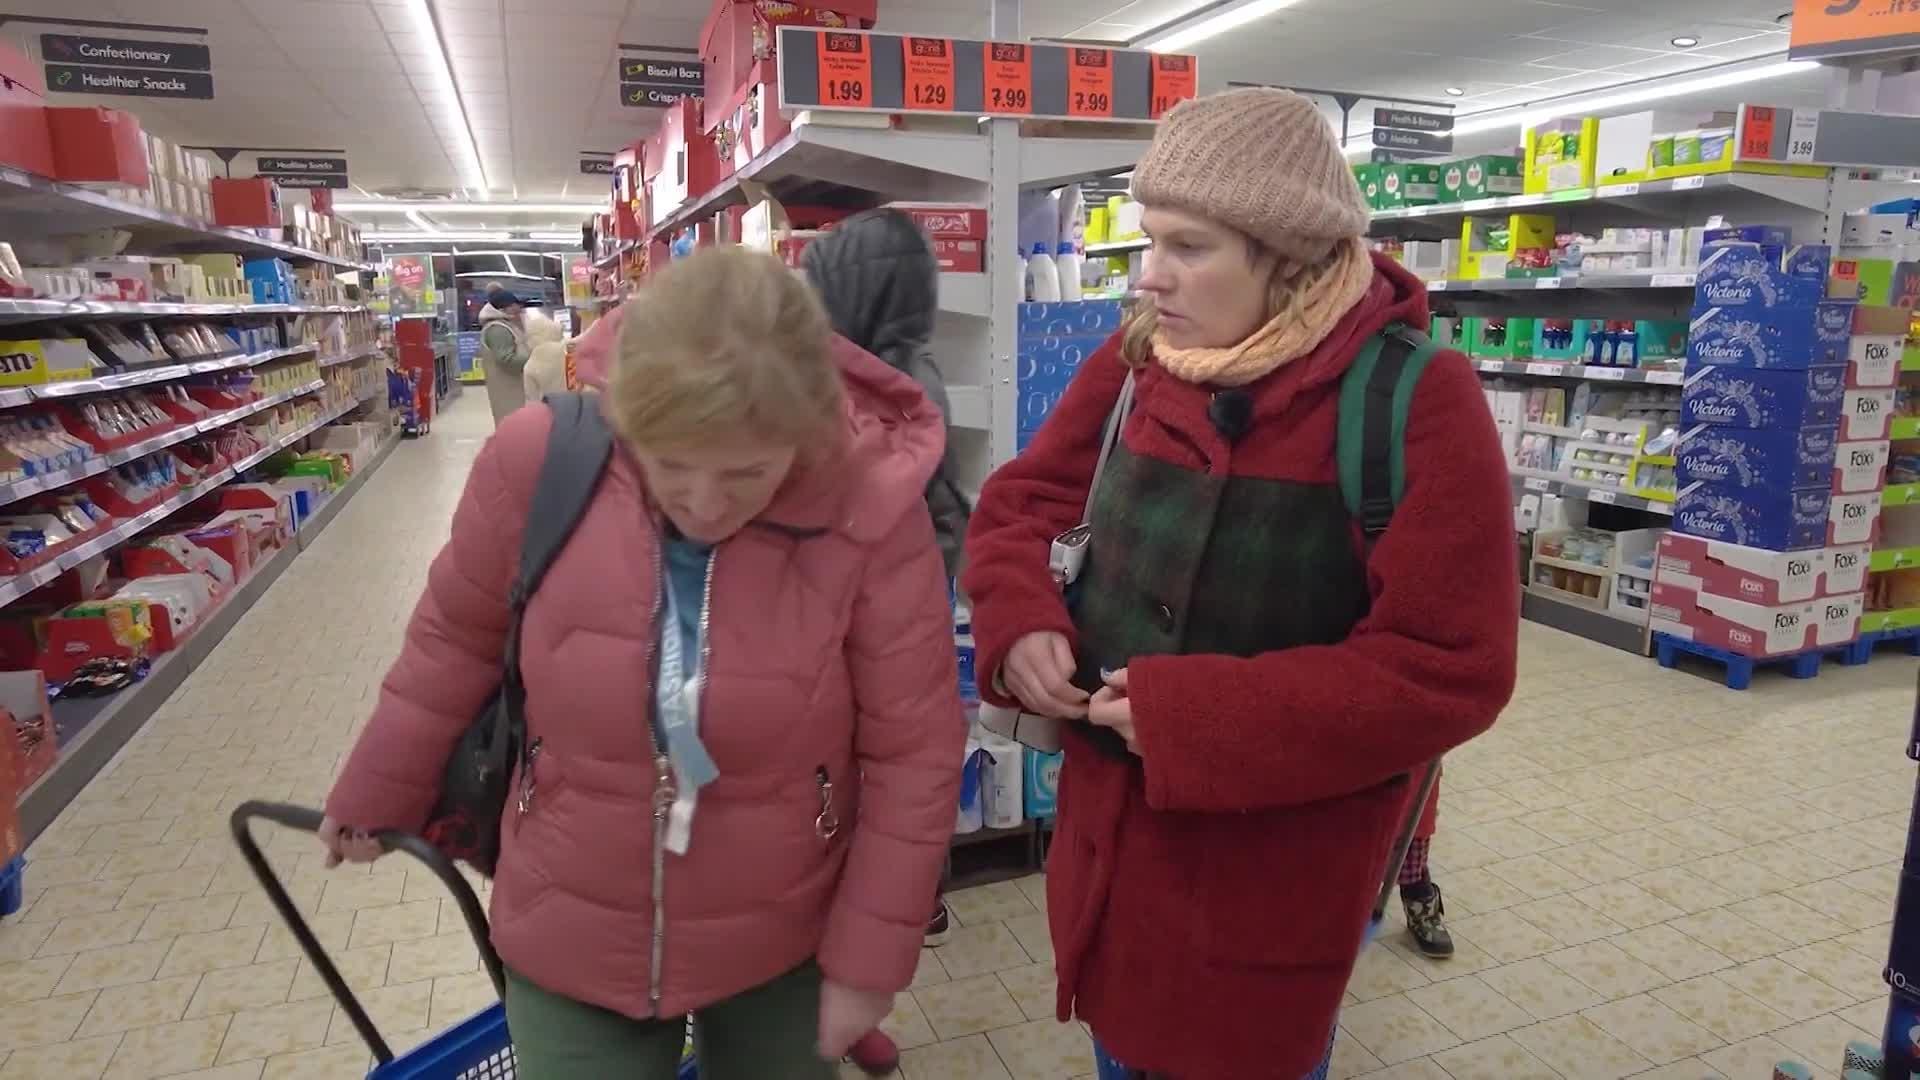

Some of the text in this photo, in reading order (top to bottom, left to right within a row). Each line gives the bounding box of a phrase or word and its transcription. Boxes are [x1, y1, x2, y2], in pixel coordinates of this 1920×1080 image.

[80, 43, 171, 63] Confectionary
[648, 65, 701, 78] Biscuit Bars
[82, 73, 186, 92] Healthier Snacks
[828, 79, 862, 101] 1.99
[913, 83, 946, 104] 1.29
[991, 87, 1026, 108] 7.99
[1075, 92, 1108, 112] 7.99
[1792, 140, 1813, 155] 3.99
[1703, 282, 1753, 299] Victoria
[1695, 341, 1744, 358] Victoria
[1689, 399, 1738, 417] Victoria
[1683, 455, 1729, 475] Victoria
[1680, 511, 1726, 533] Victoria
